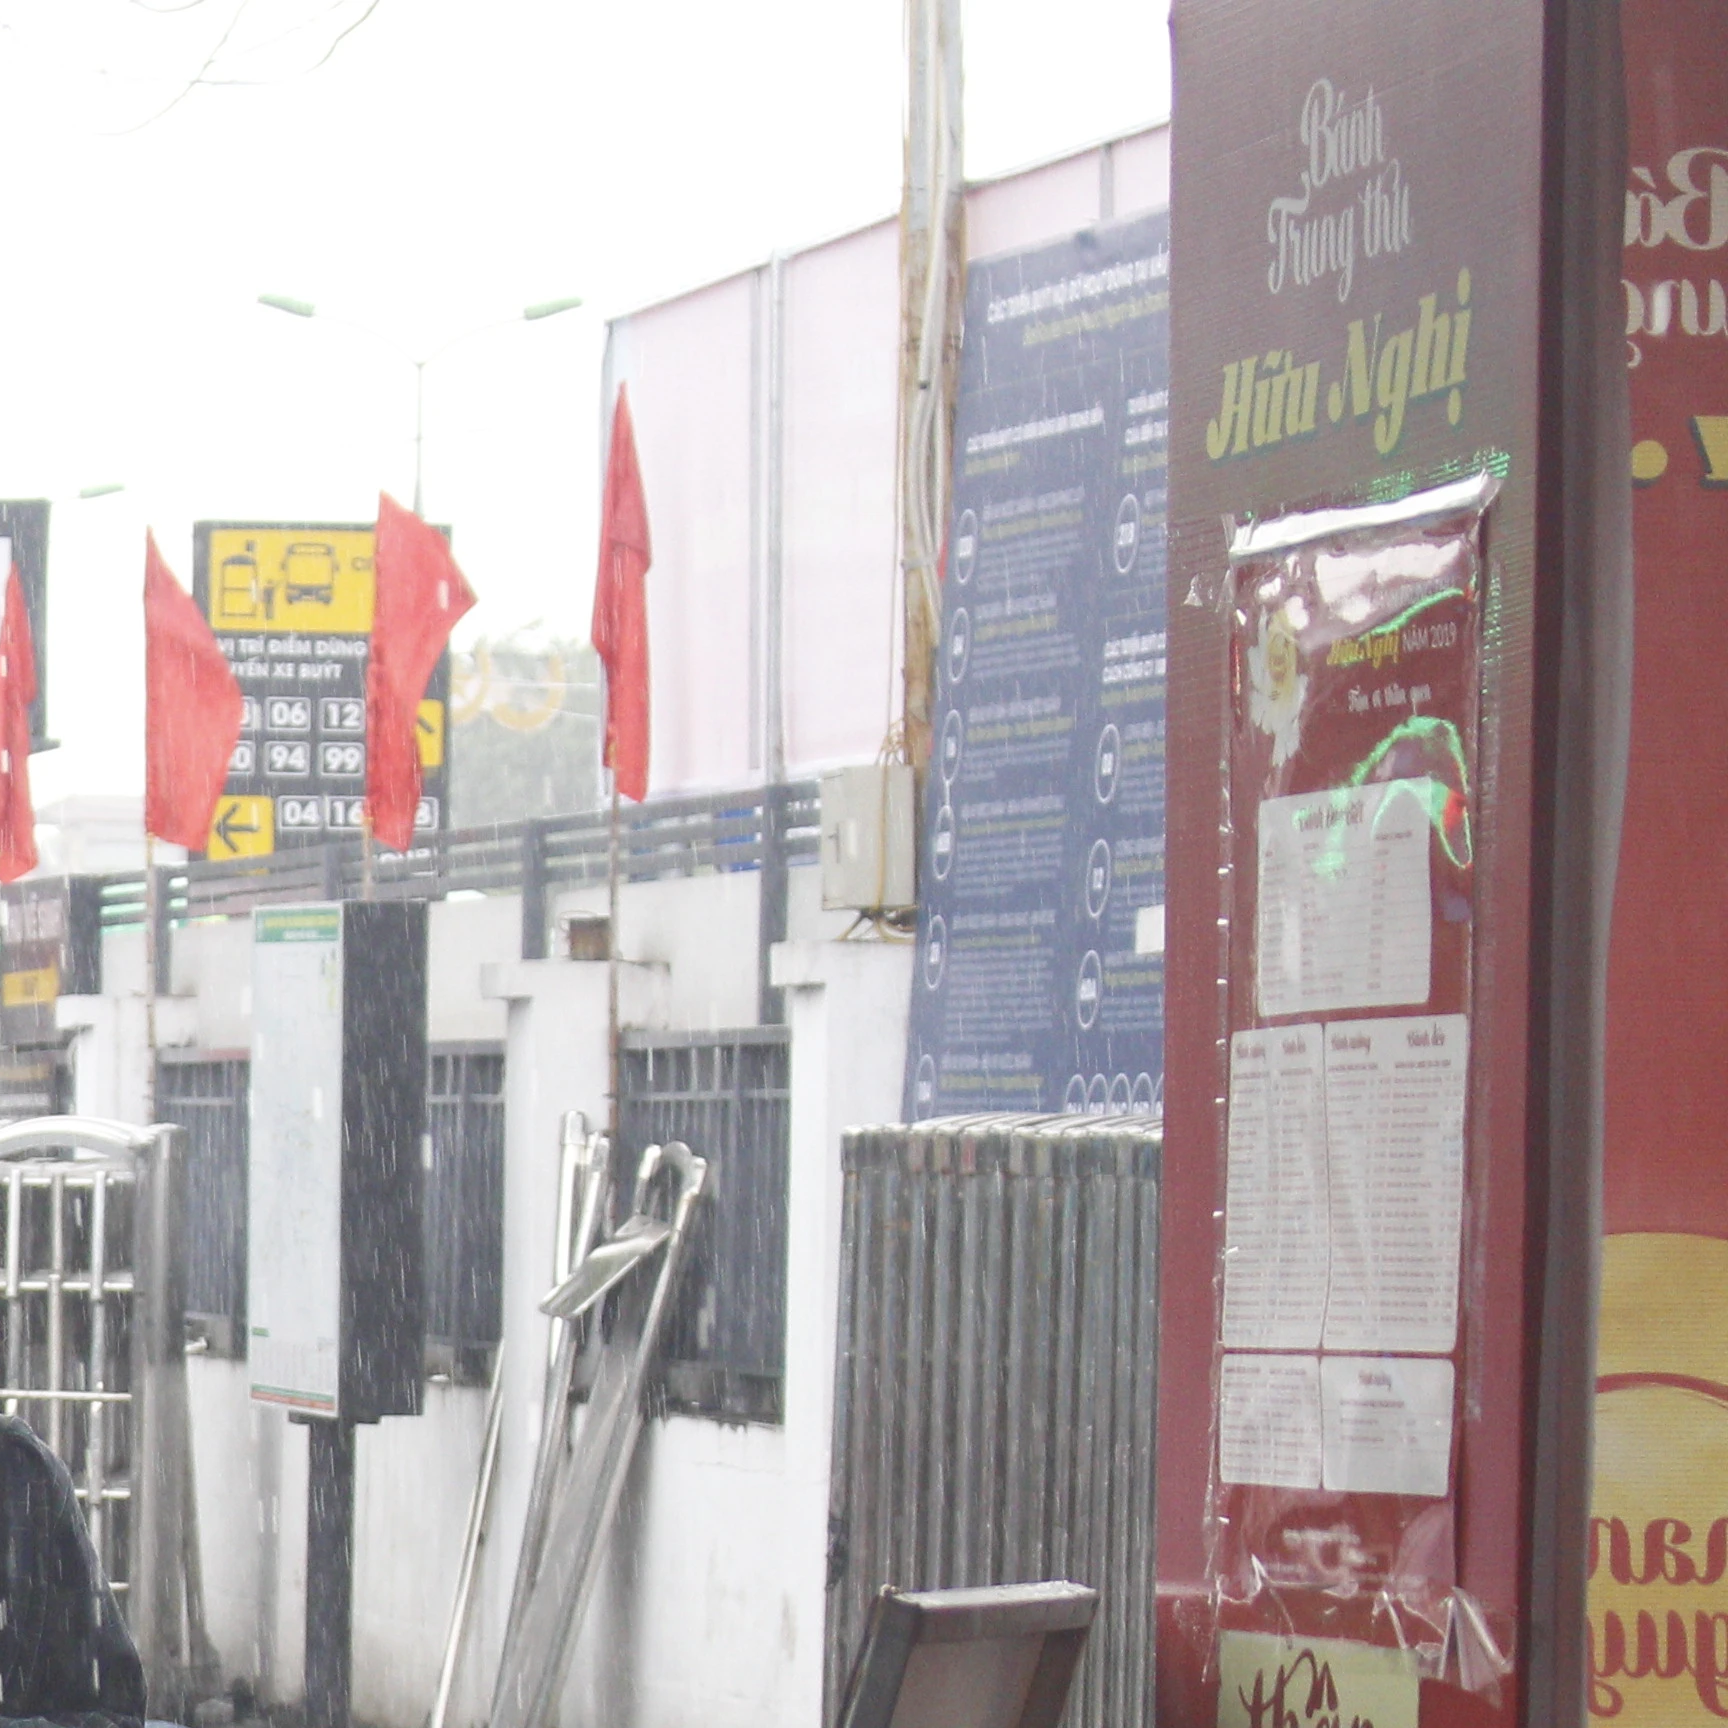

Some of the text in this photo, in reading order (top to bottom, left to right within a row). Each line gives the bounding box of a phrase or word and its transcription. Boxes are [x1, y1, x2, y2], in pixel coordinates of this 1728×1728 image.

[1300, 78, 1384, 189] Bánh
[1268, 172, 1356, 302] Trung
[1206, 349, 1321, 460] Hữu
[1328, 267, 1472, 456] Nghị
[238, 635, 265, 656] TRÍ
[268, 633, 312, 657] ĐIỂM
[314, 636, 368, 658] DỪNG
[272, 662, 295, 678] XE
[298, 660, 344, 679] BUÝT
[271, 702, 307, 725] 06
[327, 704, 360, 727] 12
[270, 747, 306, 770] 94
[325, 748, 360, 770] 99
[284, 802, 319, 825] 04
